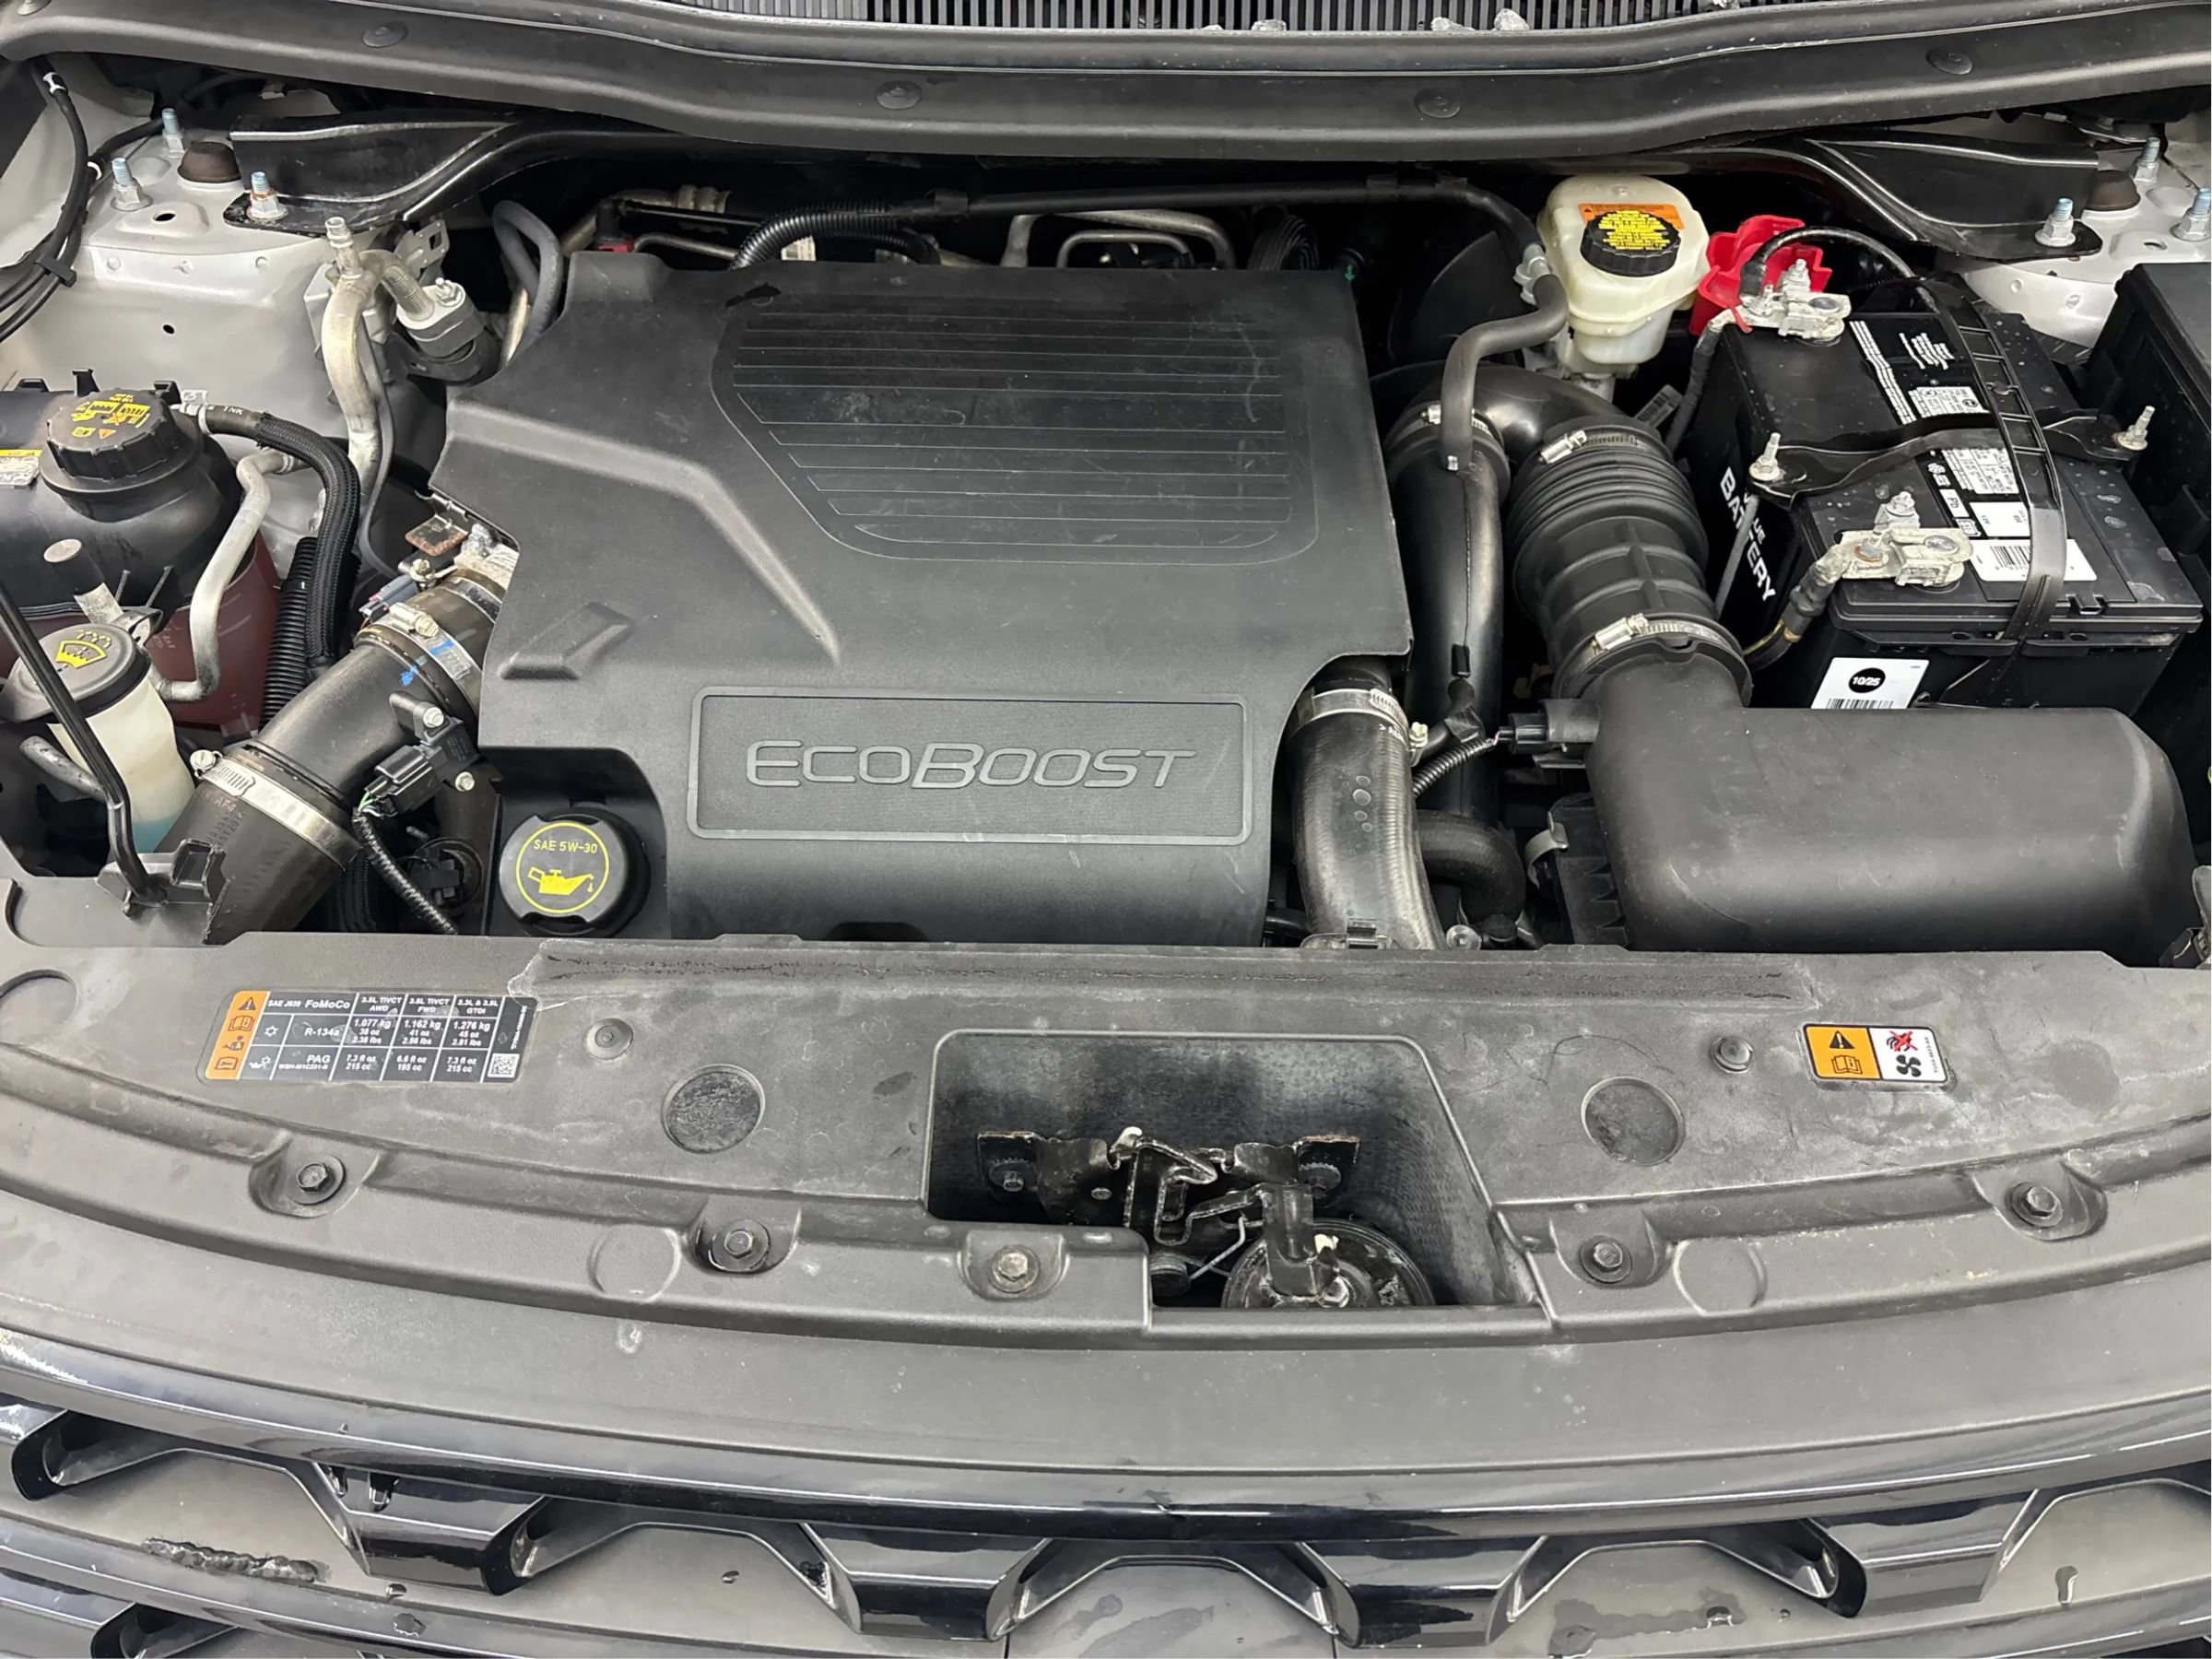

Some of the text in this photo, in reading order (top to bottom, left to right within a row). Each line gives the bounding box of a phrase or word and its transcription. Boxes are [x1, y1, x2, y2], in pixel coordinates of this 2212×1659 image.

[1743, 492, 1766, 545] VUE
[1853, 677, 1881, 687] 10/25
[534, 839, 598, 853] SAE 5W-30
[304, 999, 350, 1009] FoMoCo
[354, 1018, 392, 1030] 1.077 kg
[404, 1019, 441, 1031] 1.162 kg
[453, 1021, 491, 1032] 1.276 kg
[304, 1027, 340, 1037] R-134a
[306, 1054, 331, 1064] PAG
